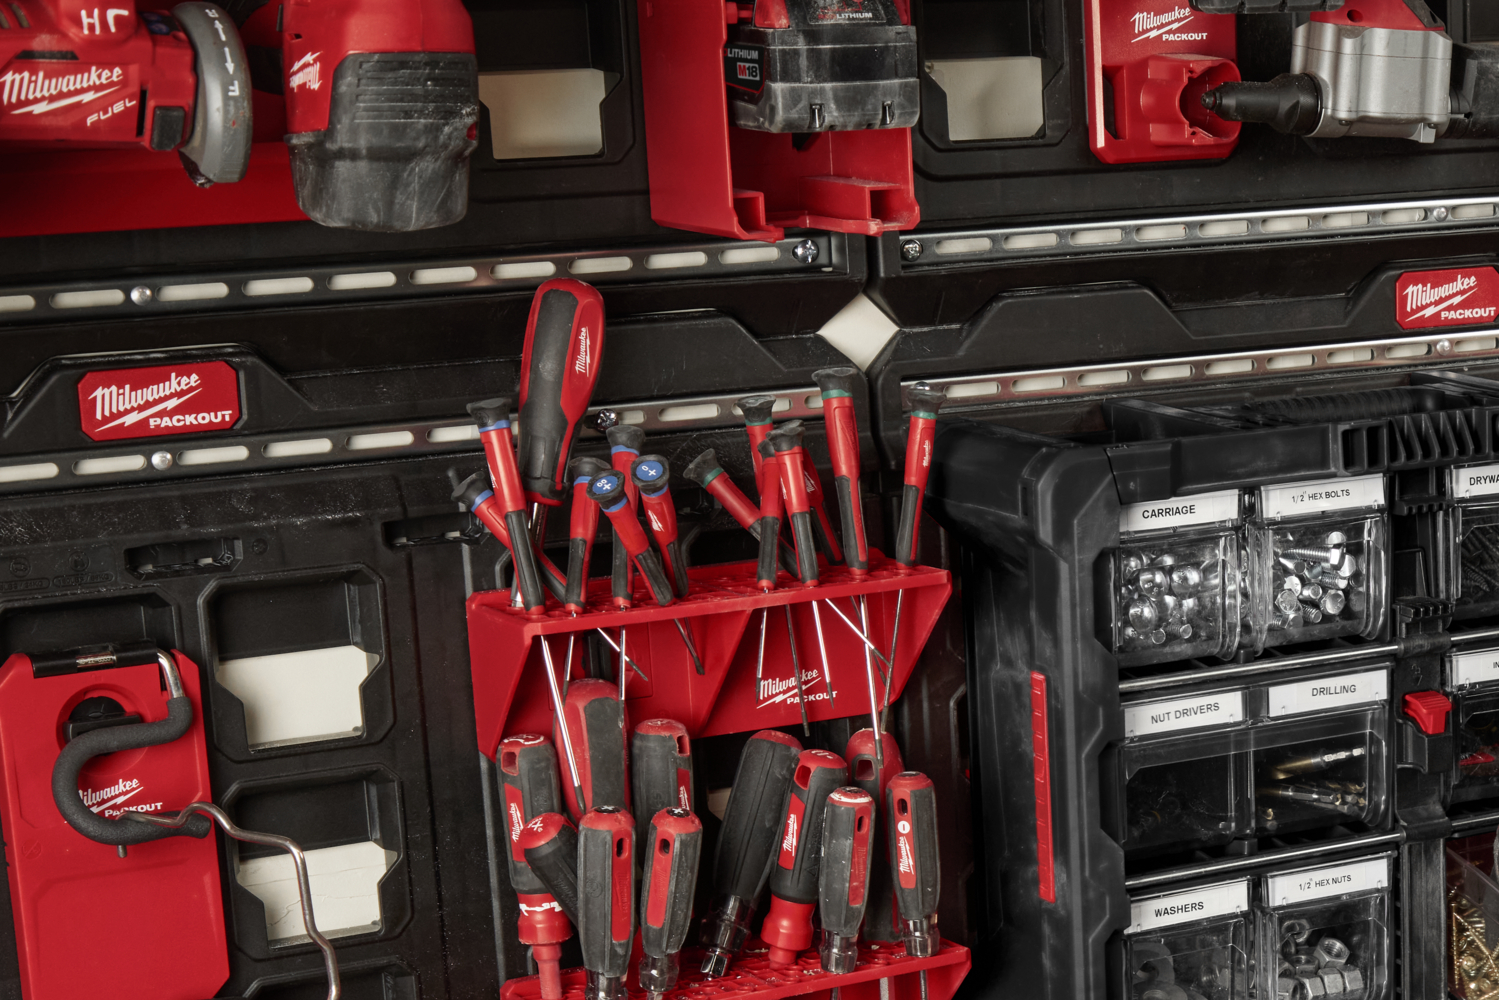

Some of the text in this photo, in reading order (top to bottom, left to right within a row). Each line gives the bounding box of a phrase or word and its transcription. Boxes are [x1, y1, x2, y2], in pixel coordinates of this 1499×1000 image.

[1130, 6, 1192, 34] Milwaukee
[1162, 33, 1208, 41] PACKOUT
[738, 64, 759, 79] M18
[0, 66, 123, 106] Milwaukee
[87, 98, 137, 127] FUEL
[1402, 274, 1478, 313] Milwaukee
[1441, 306, 1497, 320] PACKOUT
[575, 327, 586, 374] Milwaukee
[88, 373, 202, 421] Milwaukee
[149, 411, 233, 429] PACKOUT
[1308, 491, 1324, 502] HEX
[1324, 488, 1351, 500] BOLTS
[1142, 504, 1197, 519] CARRIAGE
[760, 668, 819, 701] Milwakee
[1311, 684, 1357, 697] DRILLING
[1151, 702, 1220, 724] NUT DRIVERS
[79, 778, 139, 807] ilwaukee
[783, 814, 796, 851] Milwaukee
[898, 836, 909, 873] Milwaukee
[1315, 877, 1331, 888] HEX
[1331, 874, 1352, 885] NUTS
[1154, 901, 1204, 918] WASHERS
